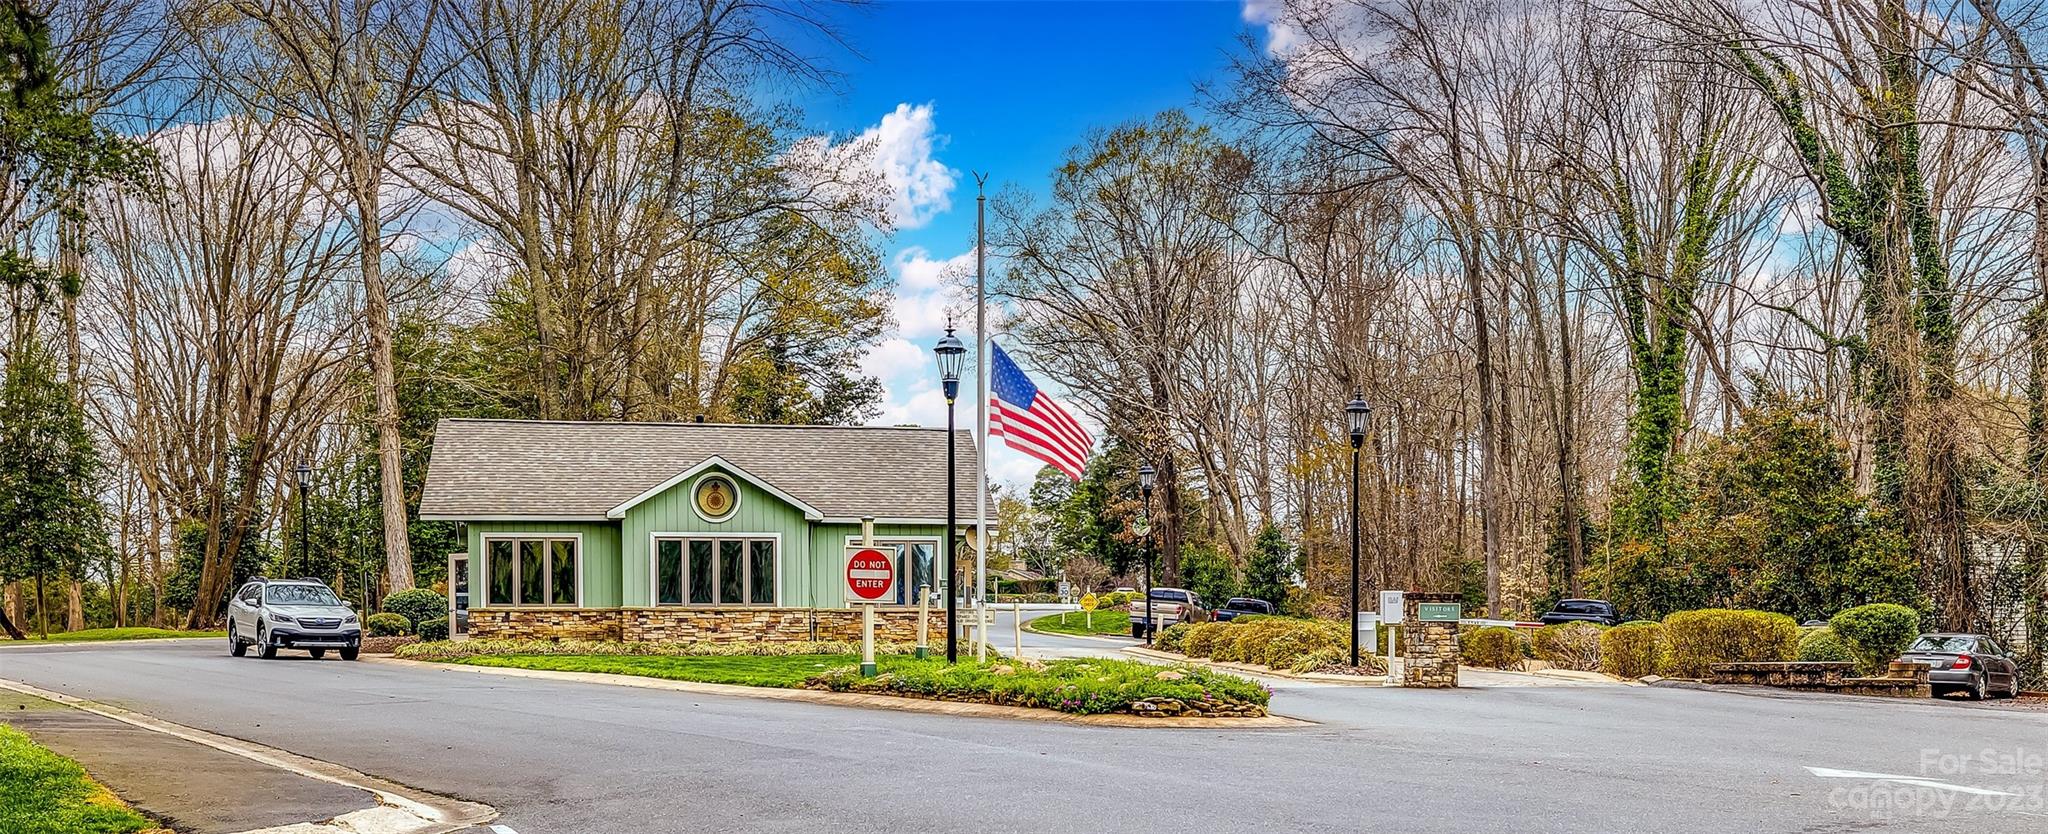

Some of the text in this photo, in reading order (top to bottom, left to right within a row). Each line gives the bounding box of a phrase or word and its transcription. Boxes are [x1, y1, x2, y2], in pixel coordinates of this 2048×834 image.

[853, 560, 886, 569] DO NOT
[856, 580, 884, 588] ENTER
